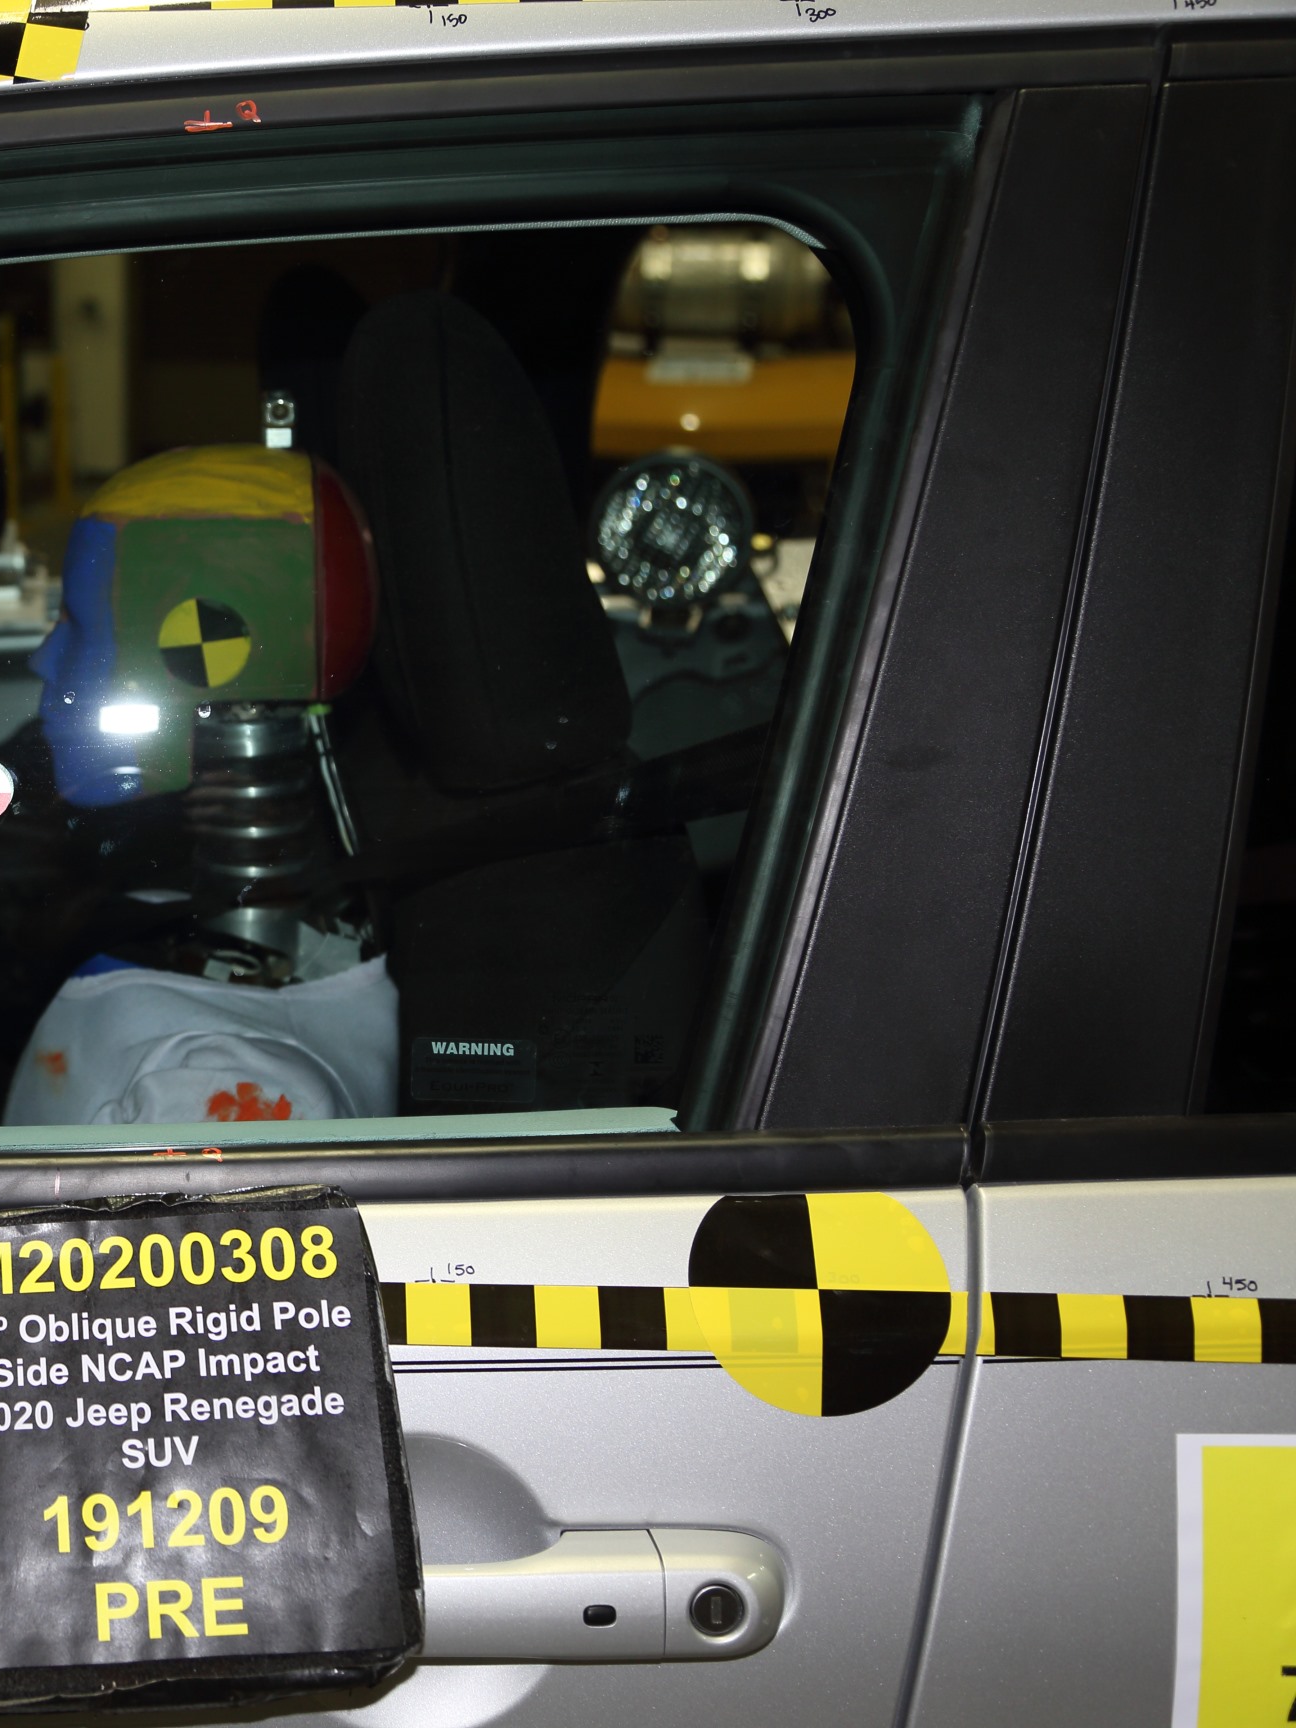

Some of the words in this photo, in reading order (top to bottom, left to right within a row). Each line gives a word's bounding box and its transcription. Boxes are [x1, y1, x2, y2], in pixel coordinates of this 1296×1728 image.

[441, 13, 468, 28] 150
[805, 7, 837, 23] 300
[431, 1041, 515, 1057] WARNING
[447, 1262, 476, 1276] 150
[1222, 1276, 1258, 1292] 450
[19, 1310, 158, 1346] Oblique
[168, 1302, 262, 1342] Rigid
[273, 1299, 353, 1331] Pole
[81, 1349, 187, 1383] NCAP
[198, 1344, 321, 1381] Impact
[65, 1397, 153, 1432] Jeep
[163, 1386, 346, 1424] Renegade
[120, 1435, 201, 1470] SUV
[42, 1484, 290, 1554] 191209
[94, 1576, 250, 1643] PRE
